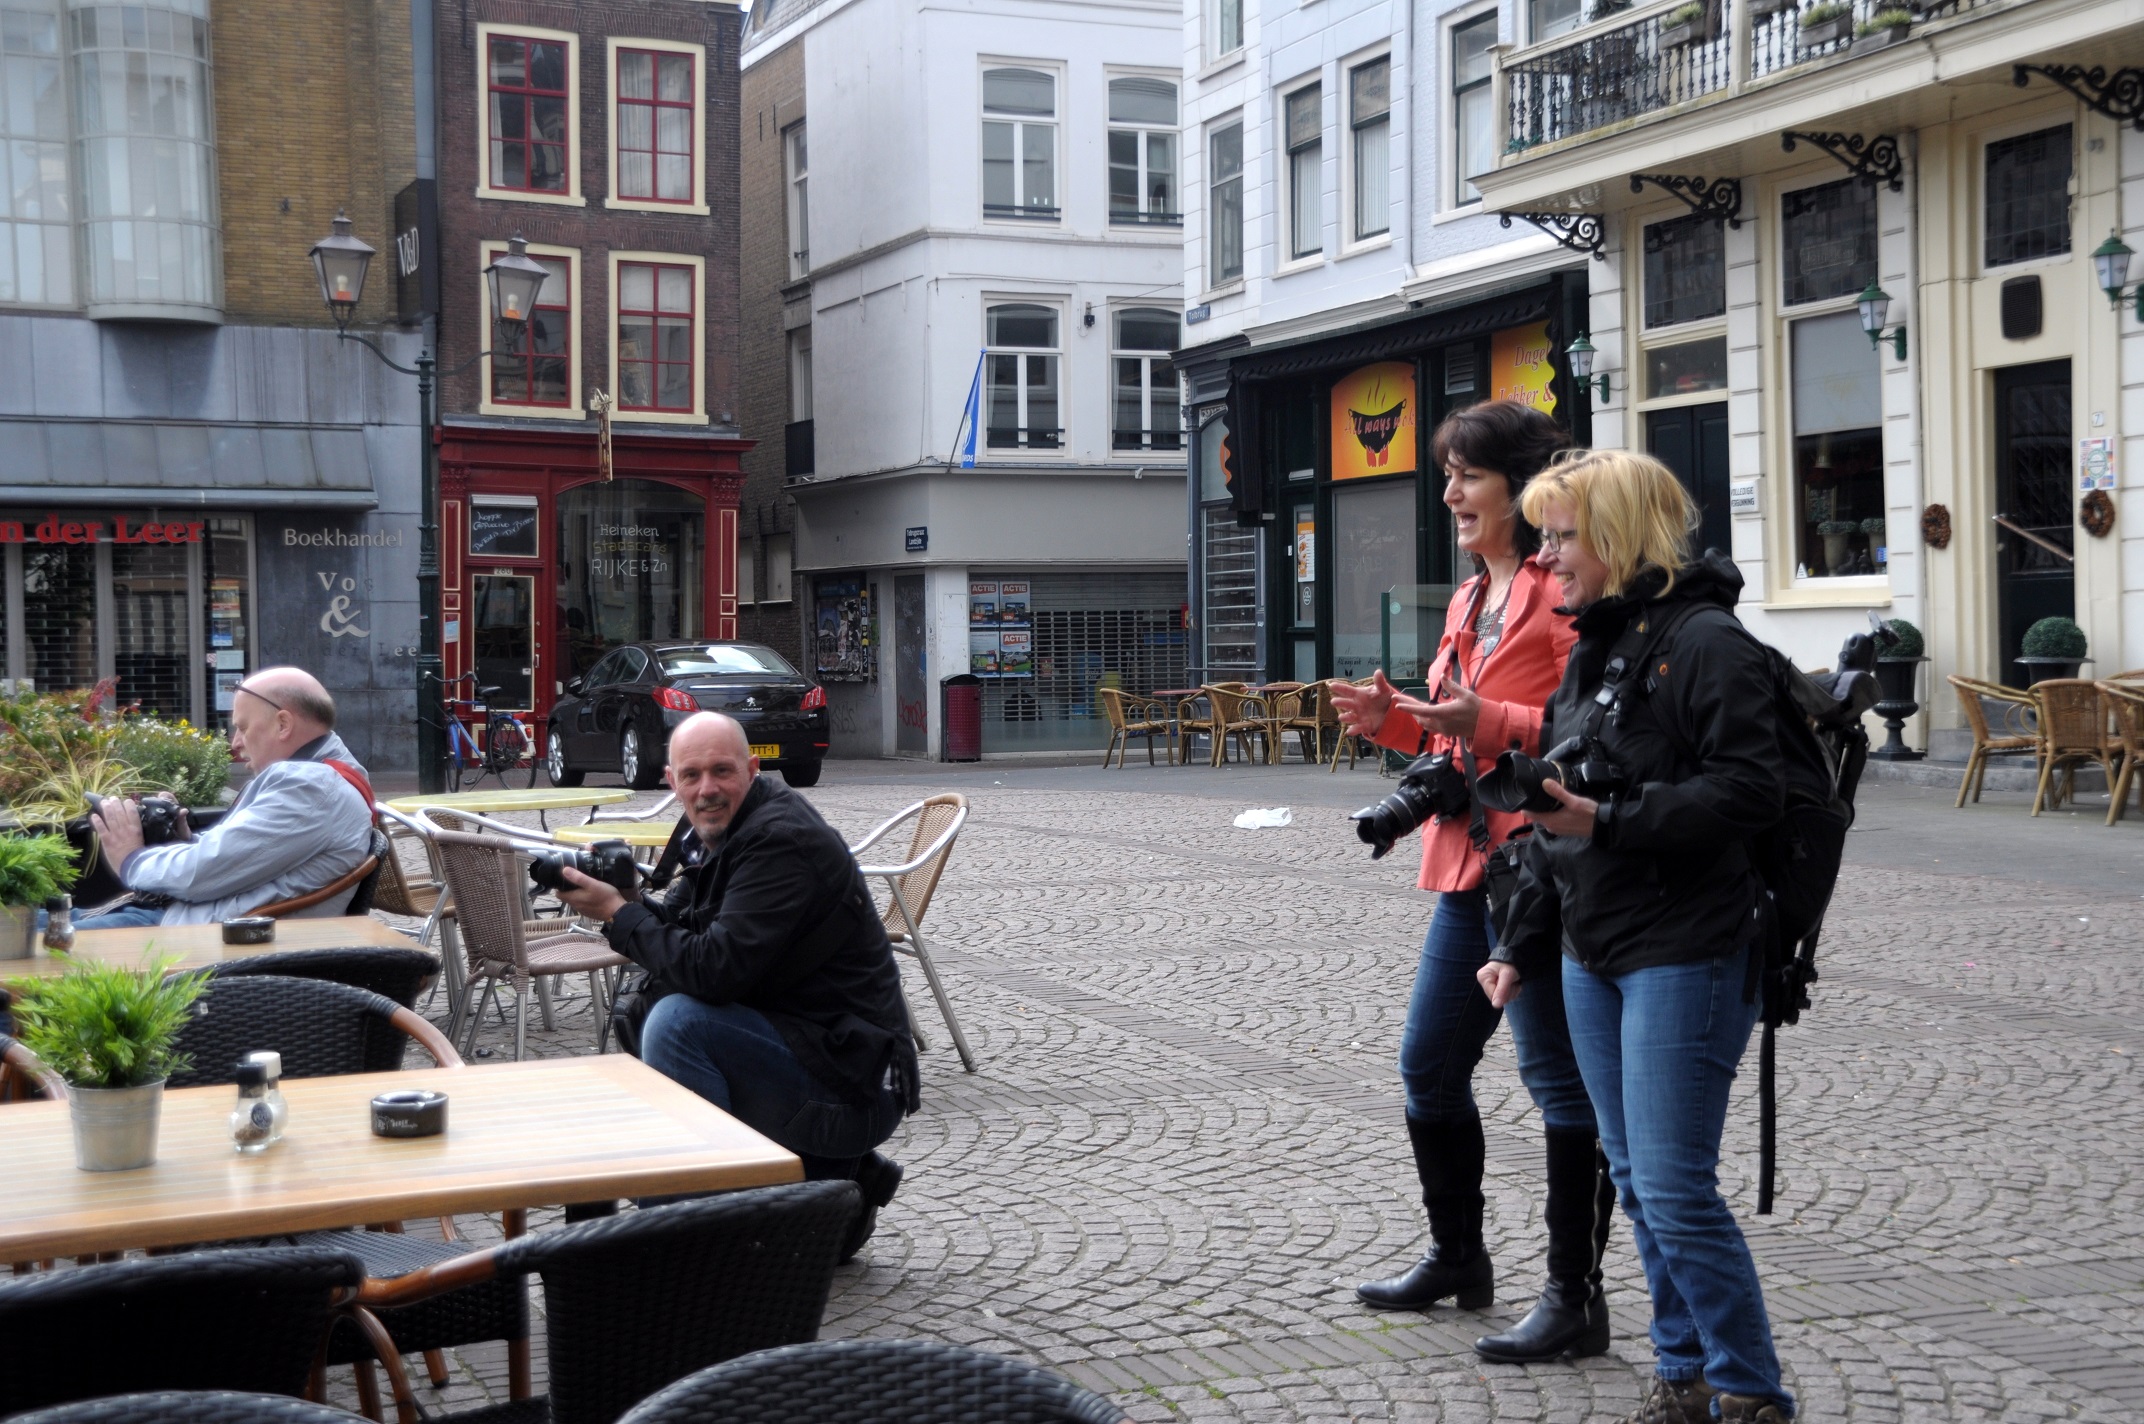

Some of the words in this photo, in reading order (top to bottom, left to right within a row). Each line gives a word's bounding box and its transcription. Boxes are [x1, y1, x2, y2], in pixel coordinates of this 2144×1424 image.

[35, 513, 103, 544] der
[112, 514, 205, 544] Leer
[284, 528, 402, 547] Boekhandel
[600, 524, 660, 537] Heineken
[592, 559, 638, 579] RIJKE
[653, 559, 668, 573] Zn
[320, 595, 371, 638] &
